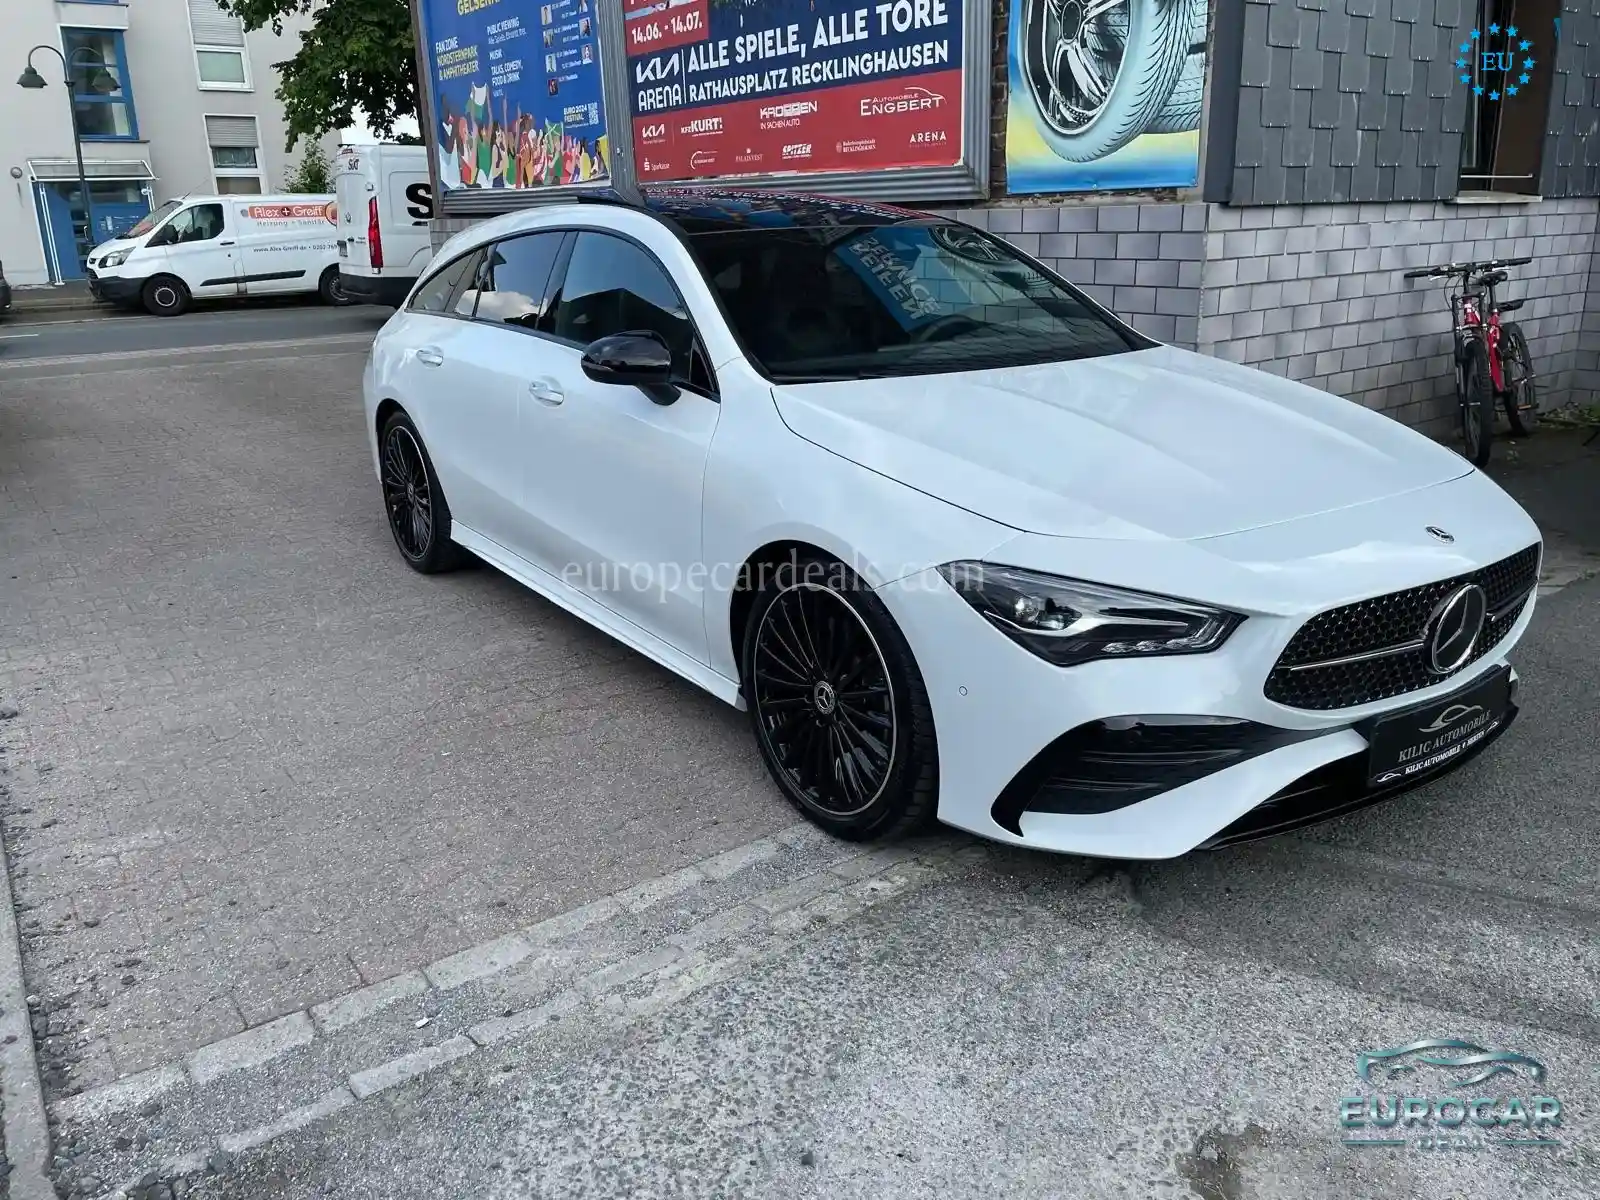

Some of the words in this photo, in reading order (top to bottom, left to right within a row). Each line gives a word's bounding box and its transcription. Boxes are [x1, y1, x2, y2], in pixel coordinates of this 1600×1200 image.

[631, 22, 663, 45] 14.06.
[671, 11, 703, 34] 14.07.
[688, 39, 730, 73] ALLE
[735, 23, 807, 64] SPIELE,
[813, 8, 868, 49] ALLE
[876, 0, 948, 36] TORE
[636, 53, 680, 84] KIA
[690, 68, 788, 102] RATHAUSPLATZ
[792, 39, 948, 87] RECKLINGHAUSEN
[638, 84, 682, 112] ARENA
[785, 118, 801, 127] AUTO
[909, 131, 947, 143] ARENA
[254, 207, 279, 217] Alex
[293, 206, 322, 217] Greiff
[1398, 740, 1432, 762] KILIC
[1432, 709, 1491, 750] AUTOMOBILE
[1405, 762, 1424, 775] KILIC
